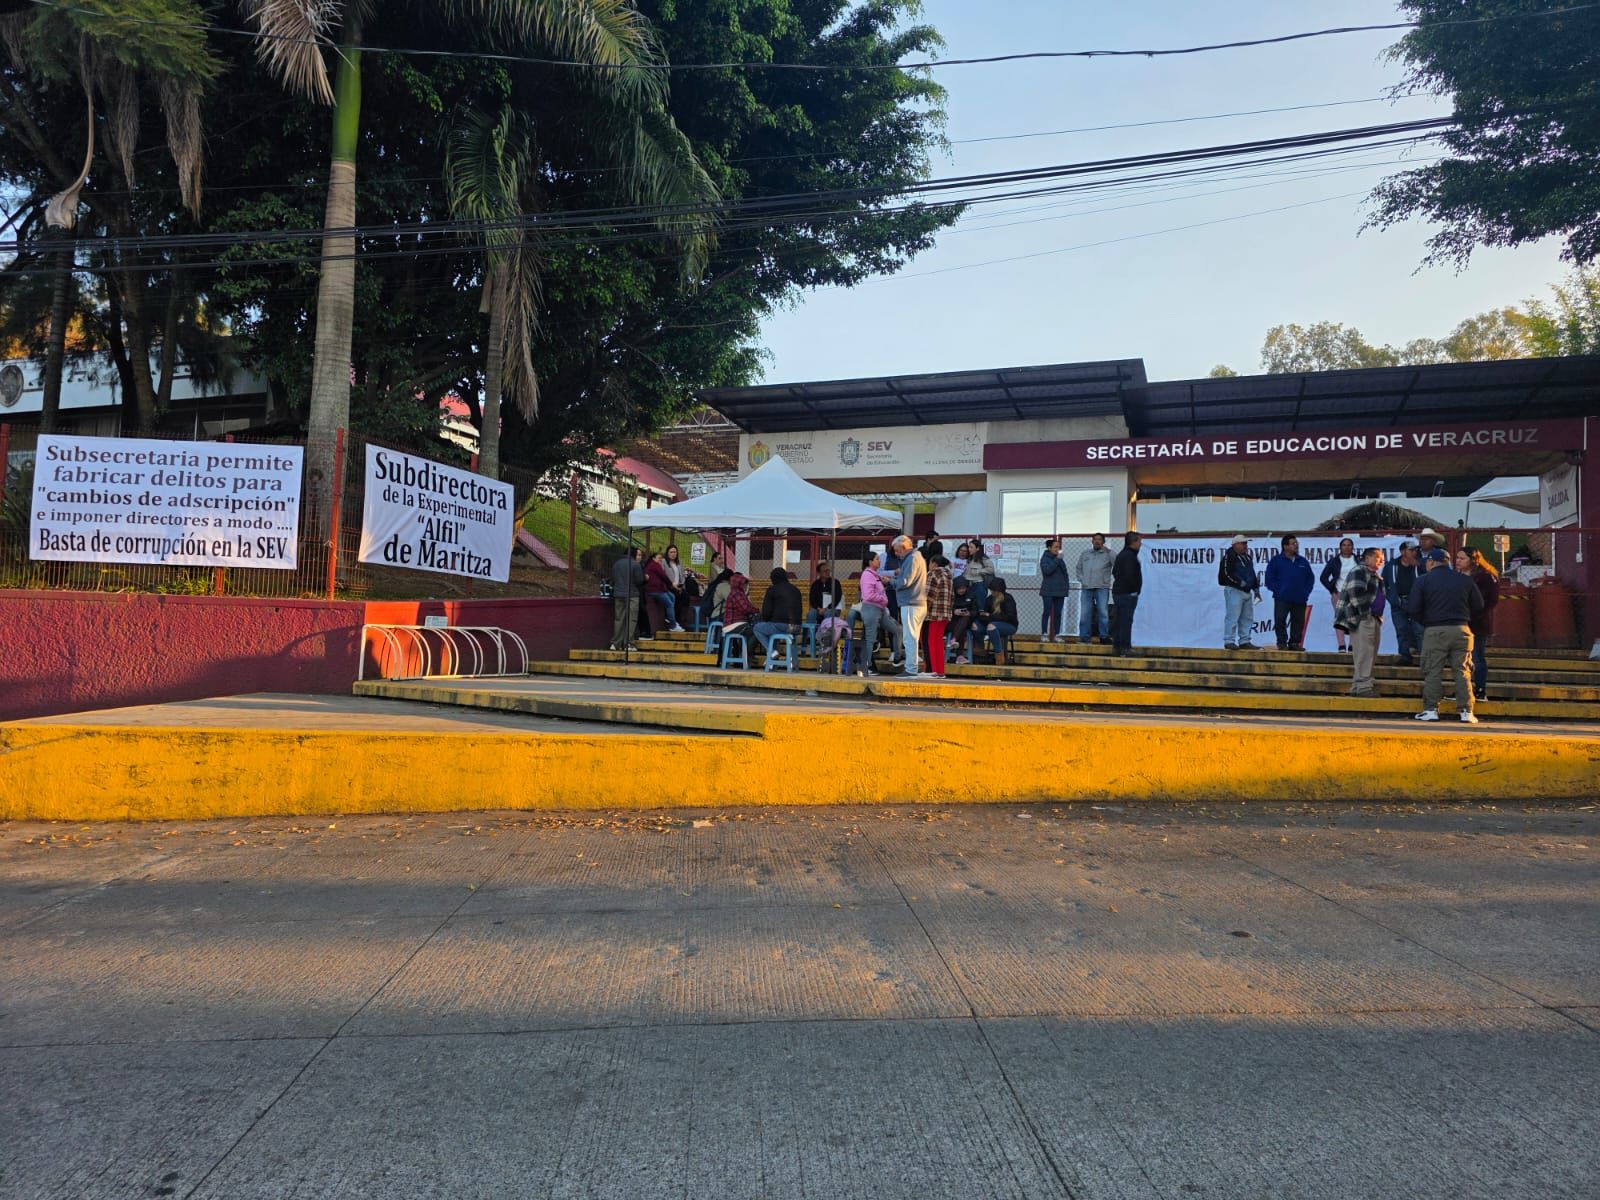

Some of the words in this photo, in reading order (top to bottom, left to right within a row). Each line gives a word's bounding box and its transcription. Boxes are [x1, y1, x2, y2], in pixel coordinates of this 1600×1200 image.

[776, 443, 812, 451] VERACRUZ
[867, 441, 893, 451] SEV
[1086, 439, 1204, 460] SECRETARÍA
[1212, 441, 1238, 456] DE
[1246, 435, 1367, 454] EDUCACION
[1375, 433, 1403, 449] DE
[1412, 428, 1539, 448] VERACRUZ
[46, 445, 199, 467] Subsecretaria
[206, 454, 293, 472] permite
[53, 465, 145, 485] fabricar
[150, 469, 226, 489] delitos
[231, 476, 282, 494] para
[375, 451, 507, 511] Subdirectora
[38, 486, 132, 505] "cambios
[138, 490, 162, 506] de
[167, 492, 294, 513] adscripción"
[383, 484, 399, 503] de
[402, 488, 414, 507] la
[418, 492, 496, 526] Experimental
[36, 510, 46, 521] e
[50, 508, 122, 525] imponer
[126, 511, 209, 527] directores
[213, 518, 223, 528] a
[227, 516, 273, 530] modo
[39, 527, 86, 552] Basta
[91, 529, 111, 553] de
[116, 531, 207, 561] corrupción
[211, 538, 232, 558] en
[237, 534, 252, 559] la
[256, 536, 288, 560] SEV
[383, 533, 412, 564] de
[417, 539, 492, 577] Maritza
[1151, 547, 1216, 564] SINDICATO
